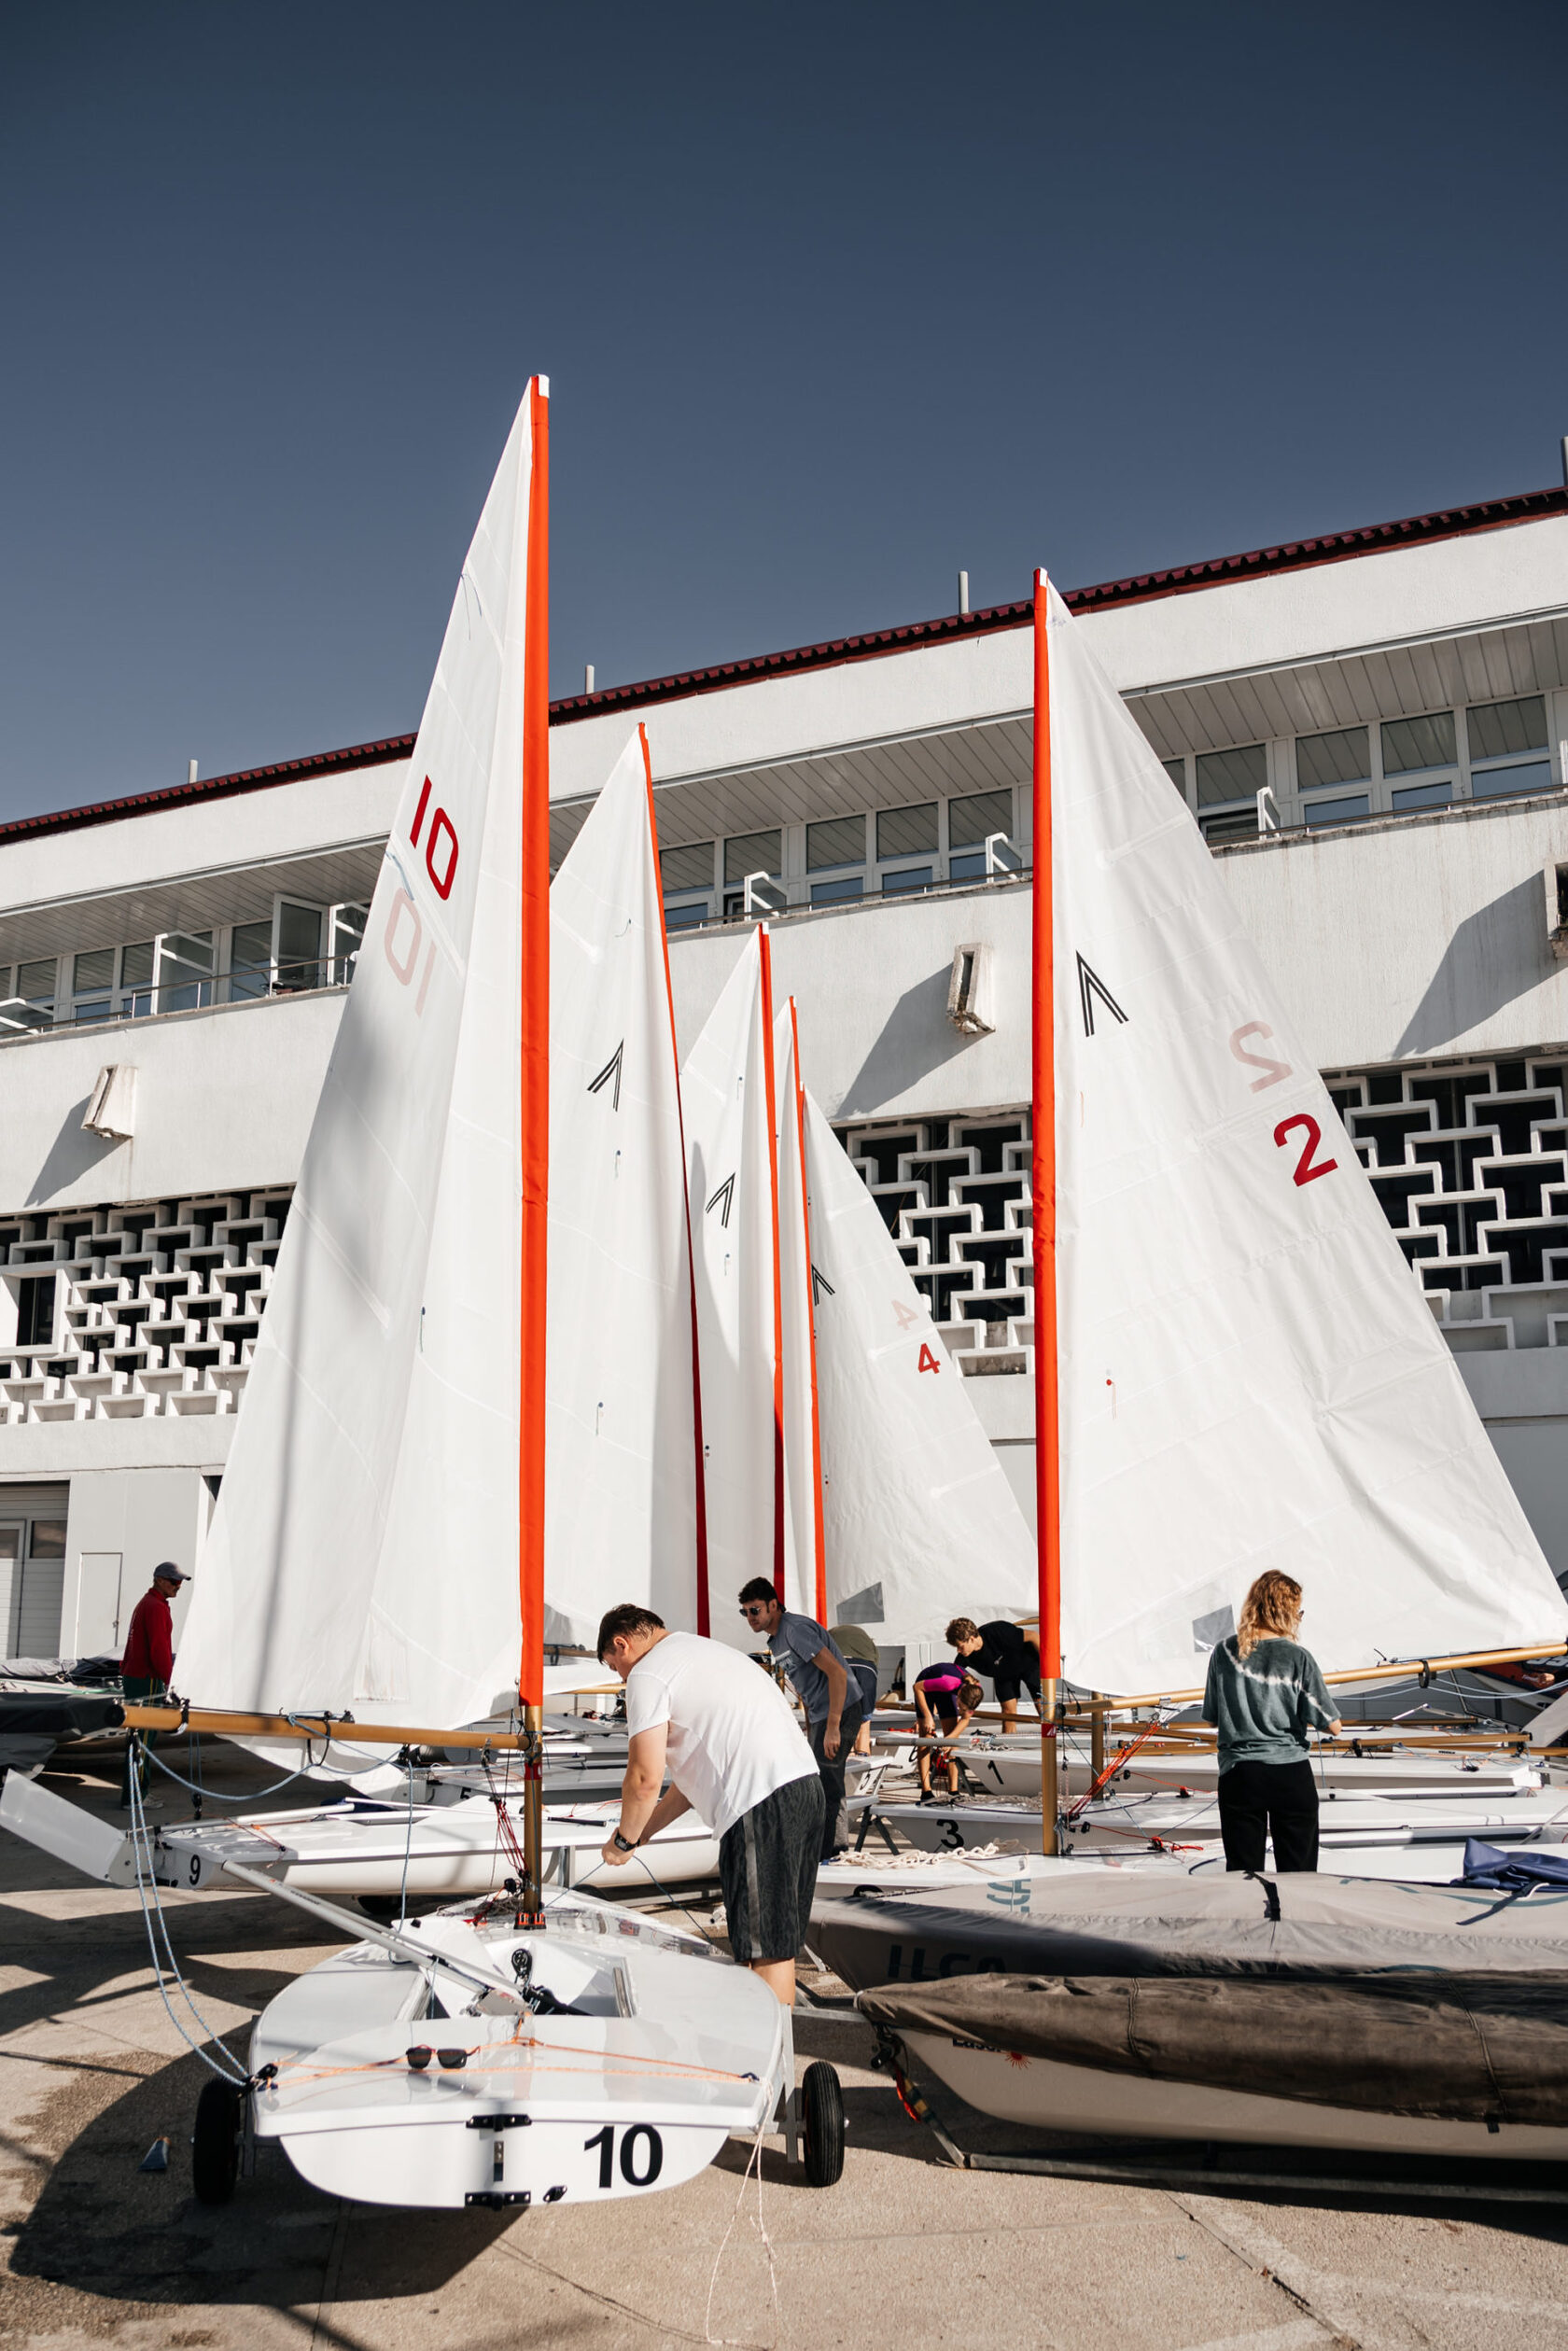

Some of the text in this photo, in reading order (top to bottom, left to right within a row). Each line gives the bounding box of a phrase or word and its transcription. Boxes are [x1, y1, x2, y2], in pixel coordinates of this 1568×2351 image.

[409, 774, 459, 902] 10
[1272, 1113, 1339, 1188] 2
[917, 1341, 941, 1375] 4
[987, 1759, 1005, 1785] 1
[935, 1818, 965, 1850] 3
[189, 1854, 202, 1886] 9
[583, 2123, 664, 2190] 10
